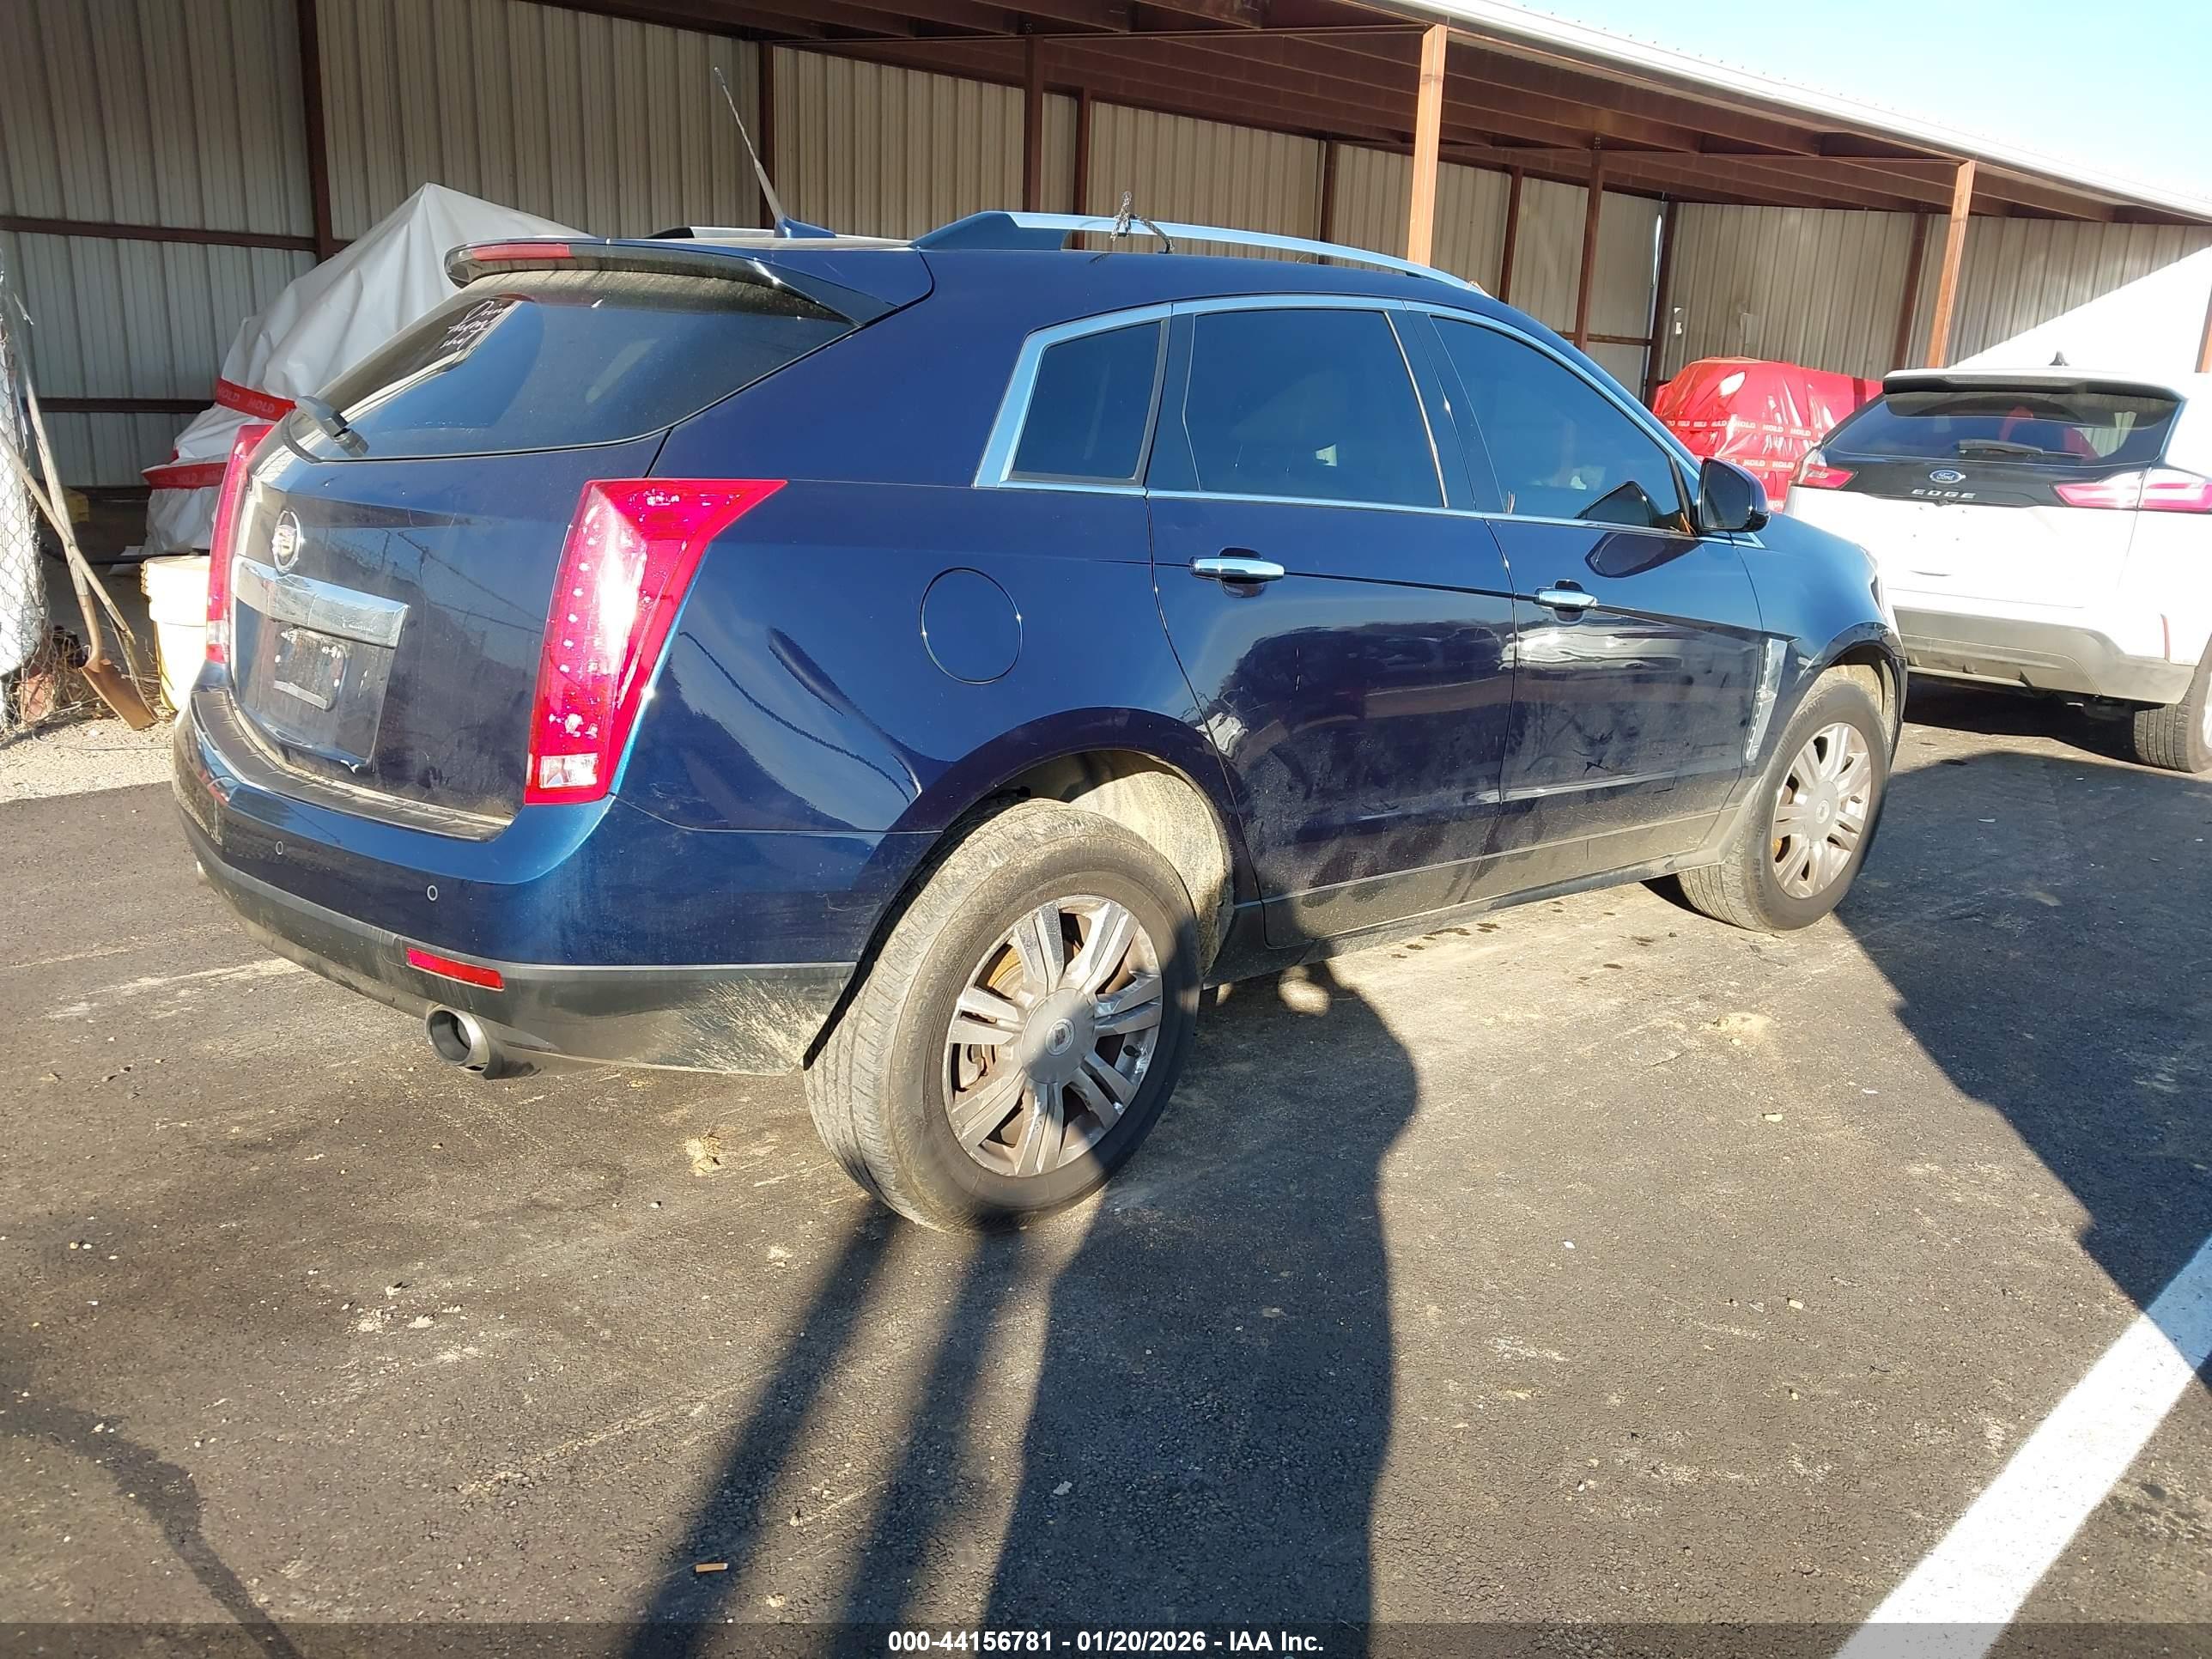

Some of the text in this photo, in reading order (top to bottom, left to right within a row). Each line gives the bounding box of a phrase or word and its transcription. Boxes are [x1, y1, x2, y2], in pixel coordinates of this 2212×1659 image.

[247, 398, 275, 413] HOLD
[1762, 424, 1784, 433] HOLD
[1790, 428, 1812, 437] HOLD
[1742, 459, 1766, 468] HOLD
[1911, 489, 1977, 499] EDGE
